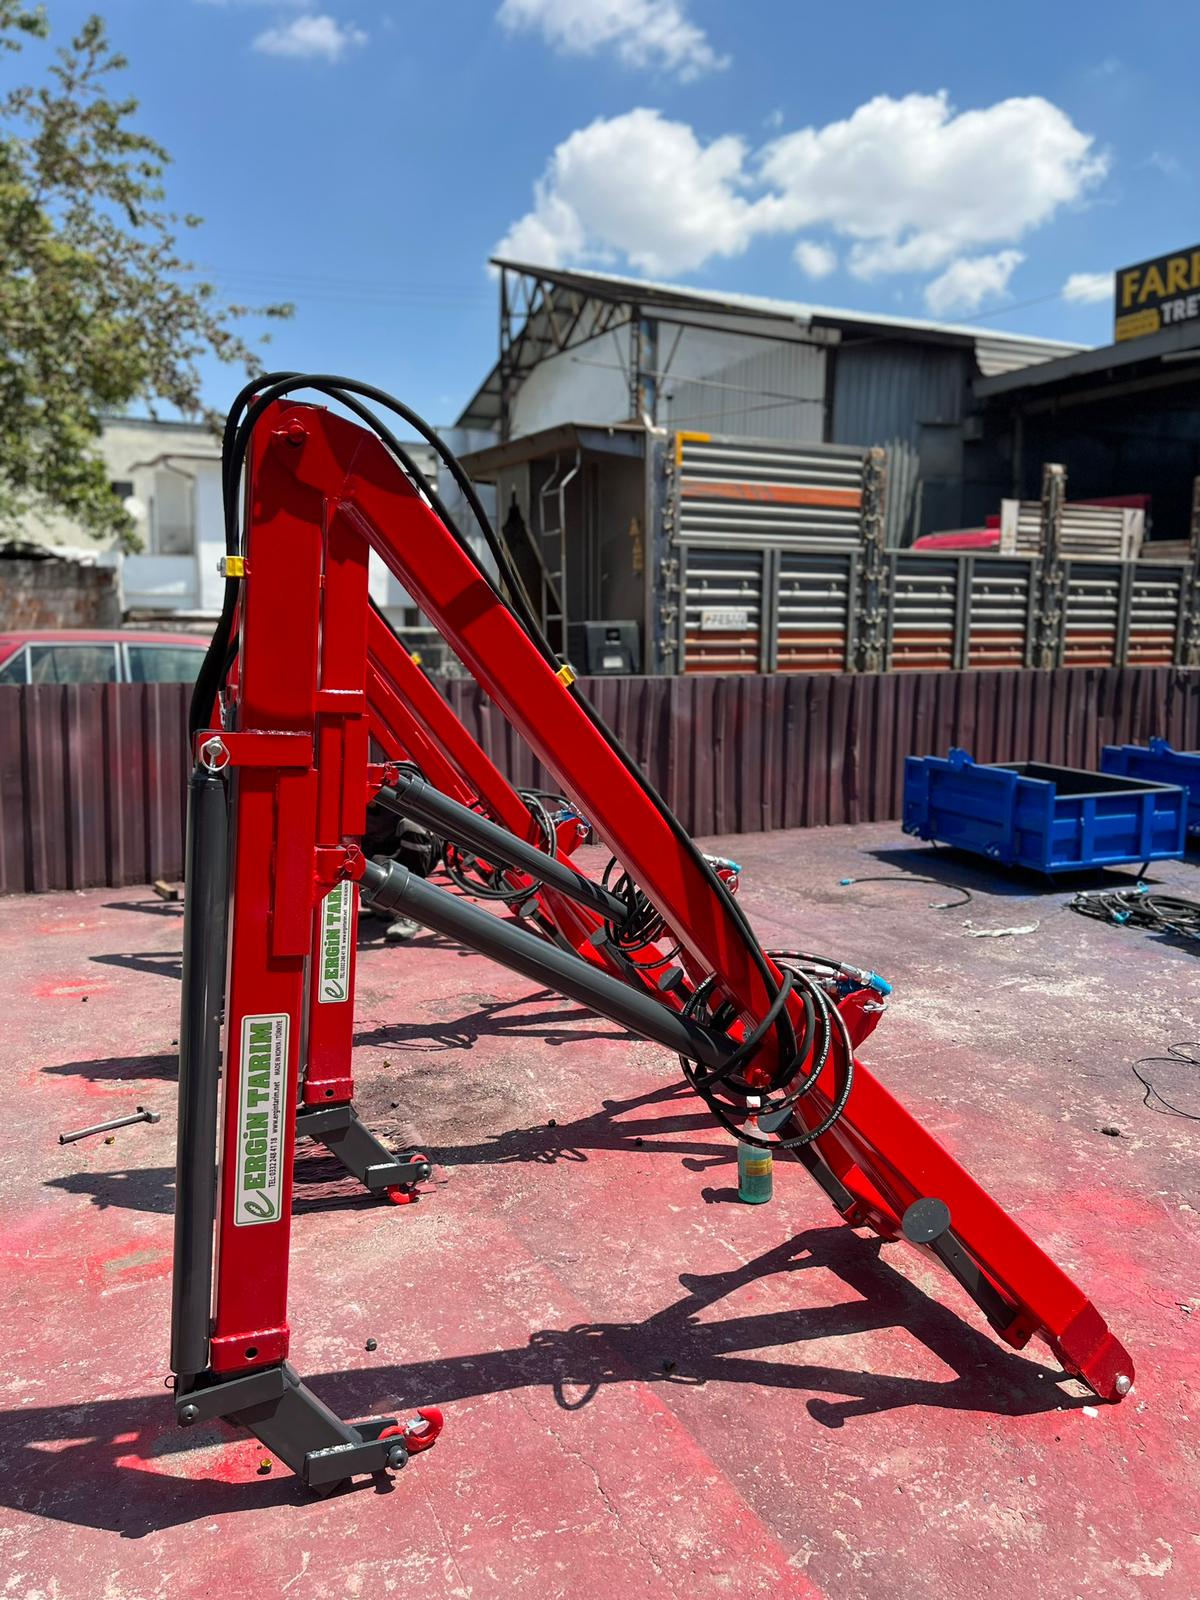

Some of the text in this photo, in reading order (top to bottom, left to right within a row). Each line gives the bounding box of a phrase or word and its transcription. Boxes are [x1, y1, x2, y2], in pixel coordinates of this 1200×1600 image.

[1161, 293, 1200, 324] TRE
[246, 1022, 272, 1107] TARIM
[271, 1081, 281, 1133] www.ergintarim.net
[269, 1152, 277, 1162] 248
